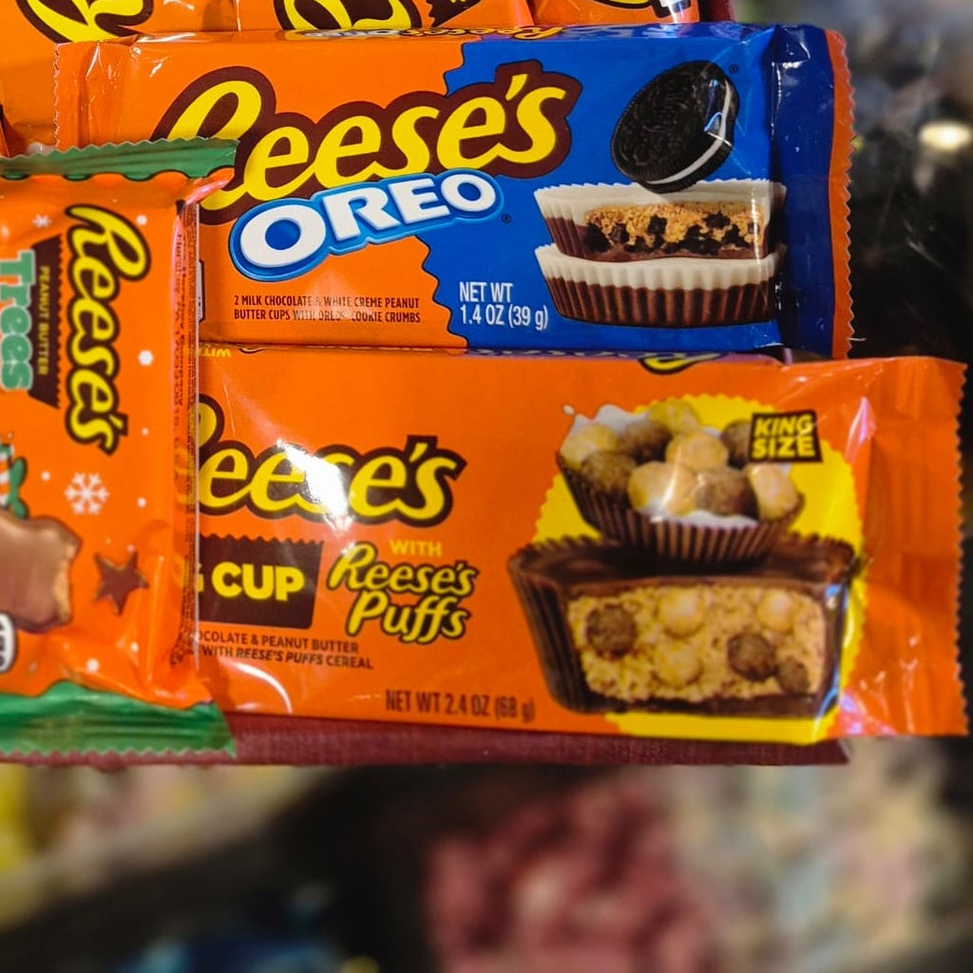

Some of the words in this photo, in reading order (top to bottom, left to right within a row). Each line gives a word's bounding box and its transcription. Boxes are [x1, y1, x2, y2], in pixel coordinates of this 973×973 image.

[235, 171, 500, 275] OREO
[38, 266, 50, 320] PEANUT
[234, 295, 239, 305] 2
[241, 295, 262, 306] MILK
[264, 295, 312, 307] CHOCOLATE
[355, 297, 382, 308] CREME
[385, 298, 419, 309] PEANUT
[459, 282, 489, 303] NET
[492, 283, 513, 303] WT
[234, 309, 266, 320] BUTTER
[269, 309, 291, 321] CUPS
[385, 311, 421, 323] CRUMBS
[459, 304, 482, 324] 1.4
[485, 305, 504, 325] OZ
[508, 305, 532, 328] (39
[535, 306, 548, 330] g)
[67, 205, 149, 454] Reese's
[37, 323, 50, 375] BUTTER
[754, 416, 814, 438] KING
[752, 437, 815, 459] SIZE
[390, 539, 442, 557] WITH
[211, 561, 305, 603] CUP
[328, 542, 479, 599] Reese's
[346, 589, 471, 645] Puffs
[198, 631, 248, 646] OCOLATE
[251, 635, 258, 646] &
[261, 635, 309, 650] PEANUT
[312, 639, 359, 653] BUTTER
[202, 645, 233, 657] WITH
[236, 647, 283, 661] REESE'S
[285, 652, 323, 666] PUFFS
[326, 655, 374, 669] CEREAL
[385, 689, 411, 712] NET
[416, 691, 440, 713] WT
[445, 693, 467, 715] 2.4
[471, 695, 490, 717] OZ
[494, 695, 518, 721] (68
[521, 697, 535, 724] g)
